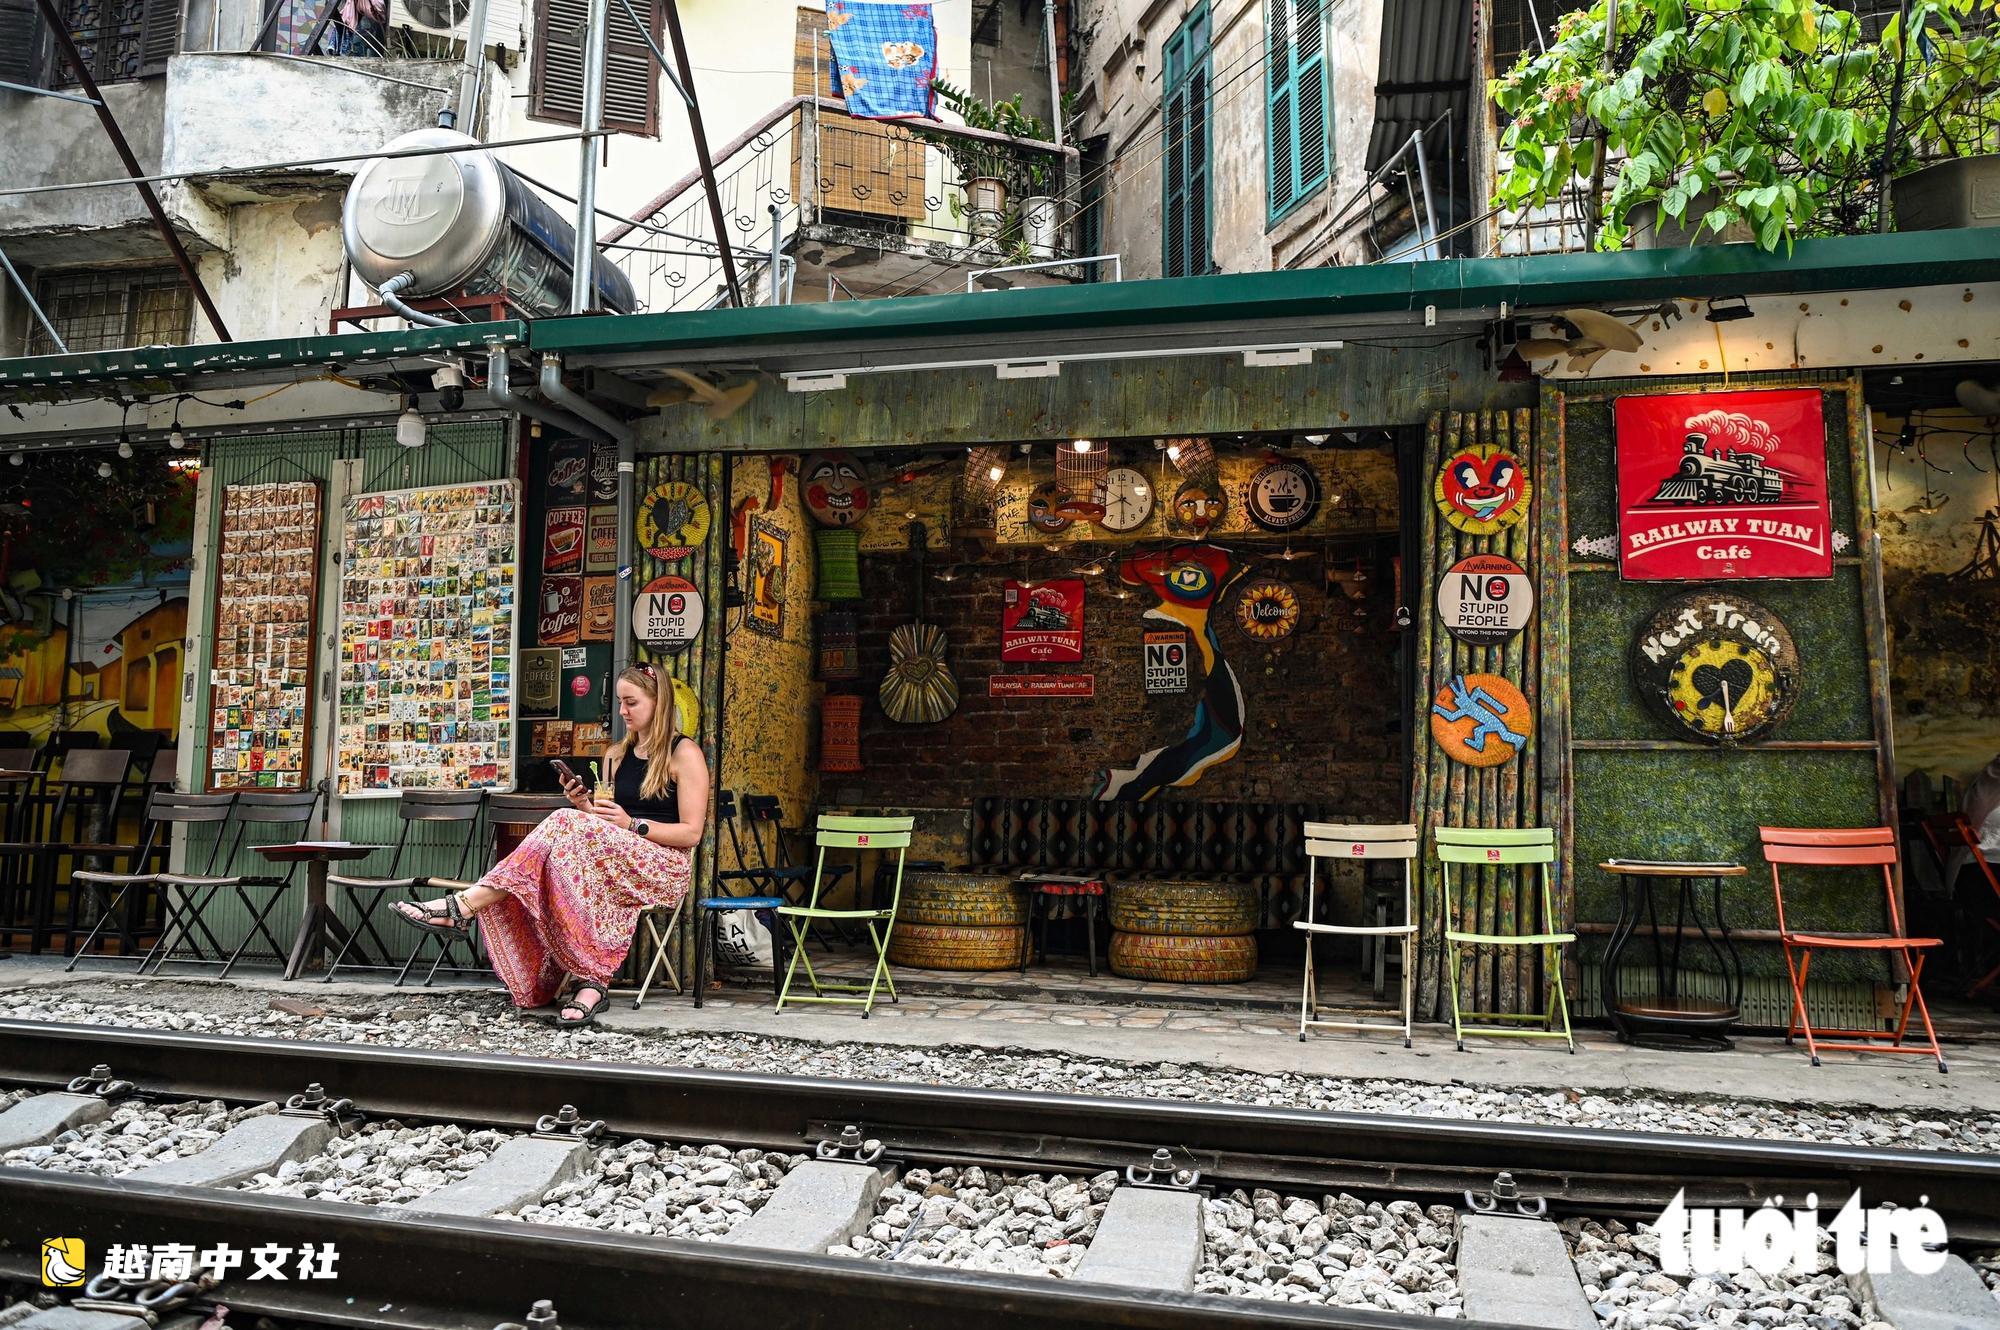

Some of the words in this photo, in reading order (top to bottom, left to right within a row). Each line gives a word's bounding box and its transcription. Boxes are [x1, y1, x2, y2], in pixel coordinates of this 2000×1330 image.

[594, 456, 619, 470] COFFE
[1117, 473, 1126, 482] 12
[1254, 464, 1282, 484] DELICIOUS
[1282, 463, 1306, 477] COFFEE
[547, 510, 584, 526] COFFEE
[1263, 514, 1288, 524] ALWAYS
[1288, 509, 1306, 521] FRESH
[591, 527, 617, 540] COFFE
[1629, 518, 1740, 549] RAILWAY
[1746, 519, 1814, 542] TUAN
[1696, 545, 1752, 560] Café
[1473, 563, 1512, 571] WARNING
[1460, 574, 1510, 601] NO
[649, 593, 686, 616] NO
[1459, 602, 1509, 614] STUPID
[540, 612, 578, 634] Coffee
[648, 617, 685, 627] STUPID
[1458, 615, 1509, 627] PEOPLE
[647, 627, 685, 638] PEOPLE
[1641, 608, 1703, 664] Next
[1708, 601, 1781, 655] Train
[1005, 635, 1049, 648] RAILWAY
[1051, 635, 1077, 647] TUAN
[1147, 645, 1184, 667] NO
[523, 670, 556, 682] COFFEE
[1147, 667, 1186, 677] STUPID
[1147, 677, 1186, 688] PEOPLE
